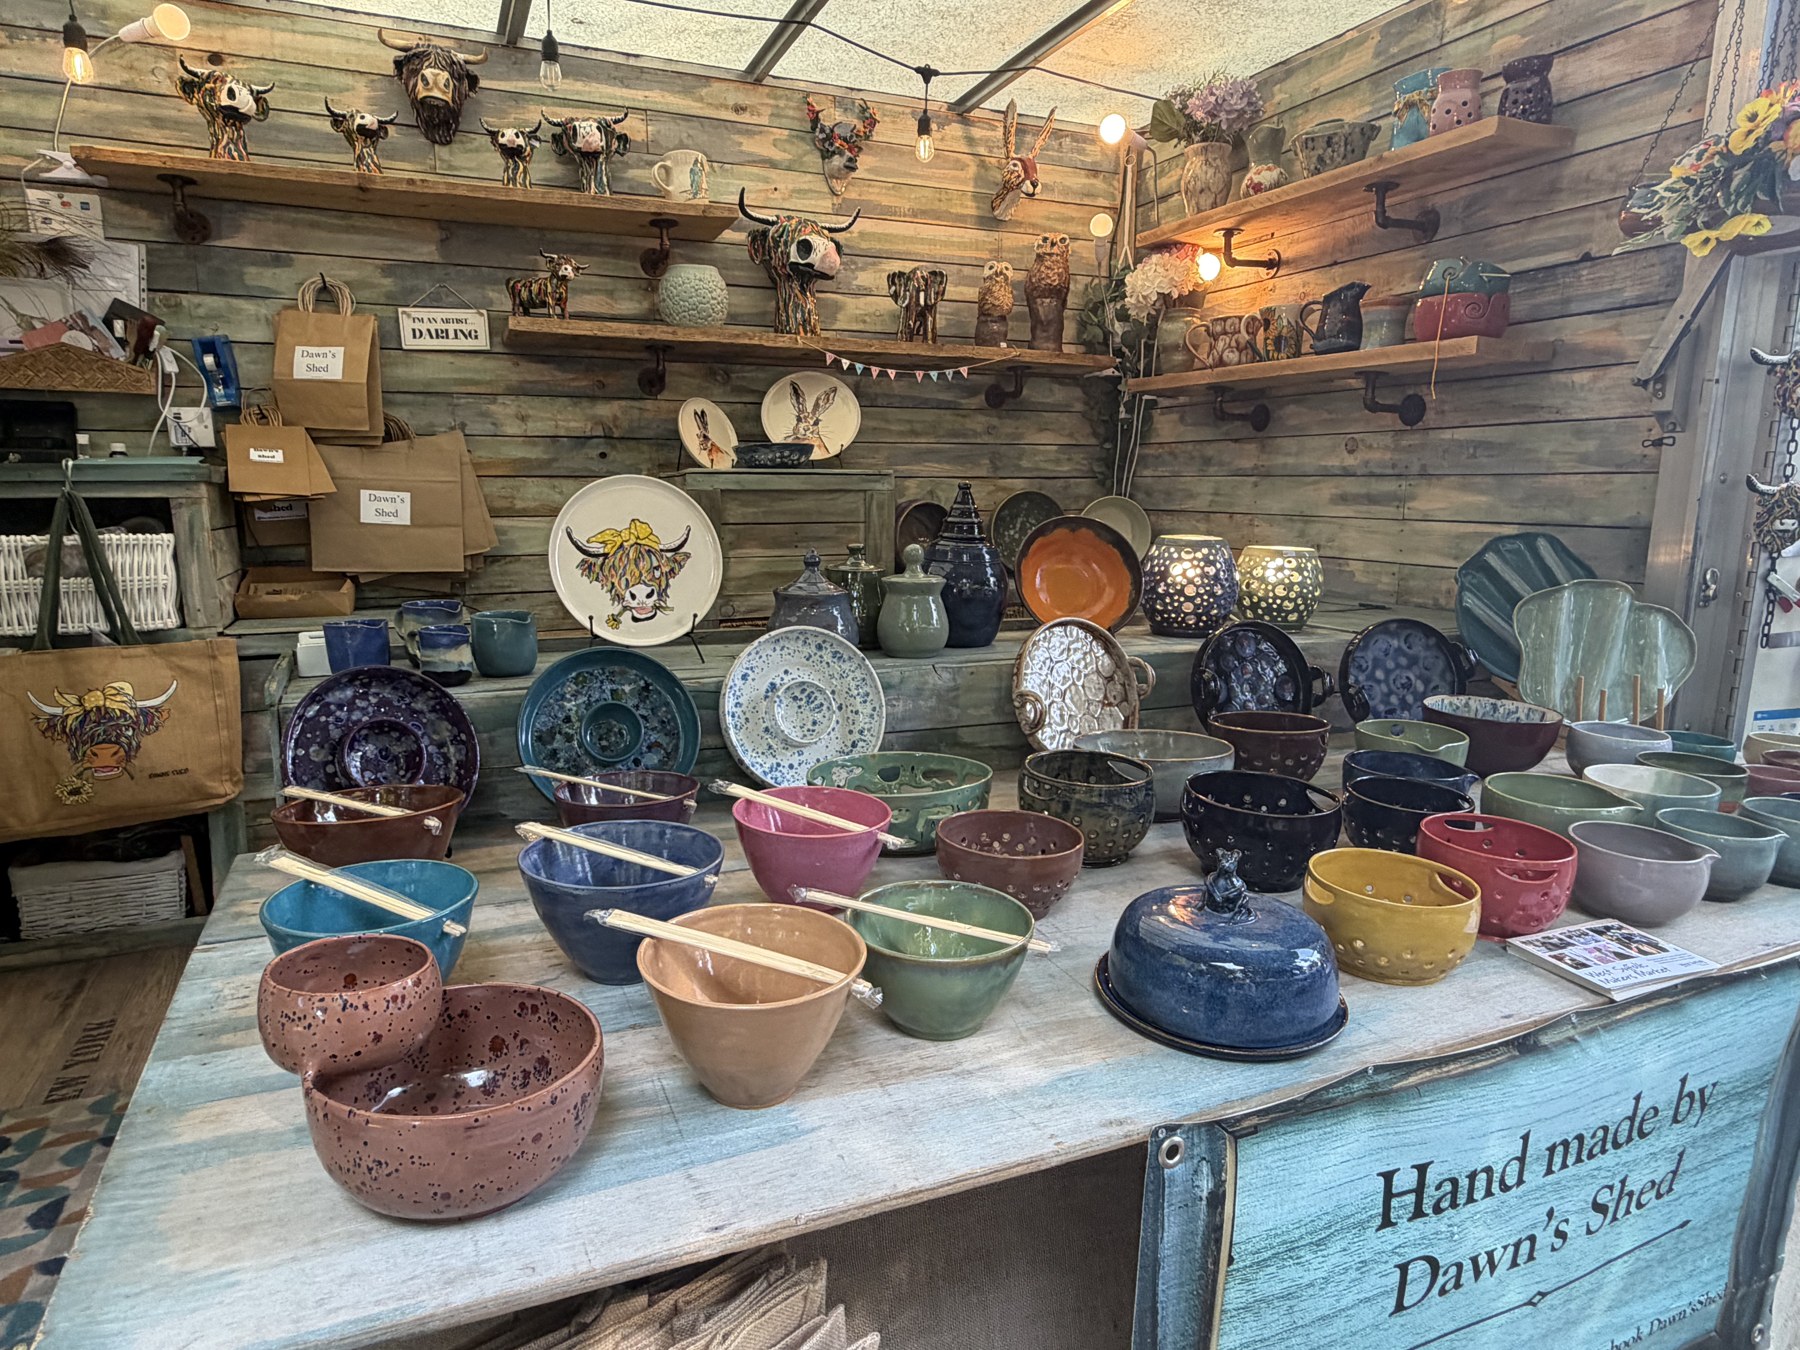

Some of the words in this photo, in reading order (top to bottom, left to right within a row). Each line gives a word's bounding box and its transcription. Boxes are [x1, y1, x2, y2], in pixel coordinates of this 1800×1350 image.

[412, 316, 425, 325] I'M
[426, 317, 438, 325] AN
[410, 327, 480, 341] DARLING
[300, 349, 337, 360] Dawn's
[305, 363, 330, 373] Shed
[368, 493, 406, 504] Dawn's
[374, 507, 399, 518] Shed
[1374, 1128, 1533, 1233] Hand
[1541, 1089, 1661, 1179] made
[1670, 1071, 1719, 1128] by
[1387, 1206, 1570, 1318] Dawn's
[1584, 1146, 1688, 1236] Shed
